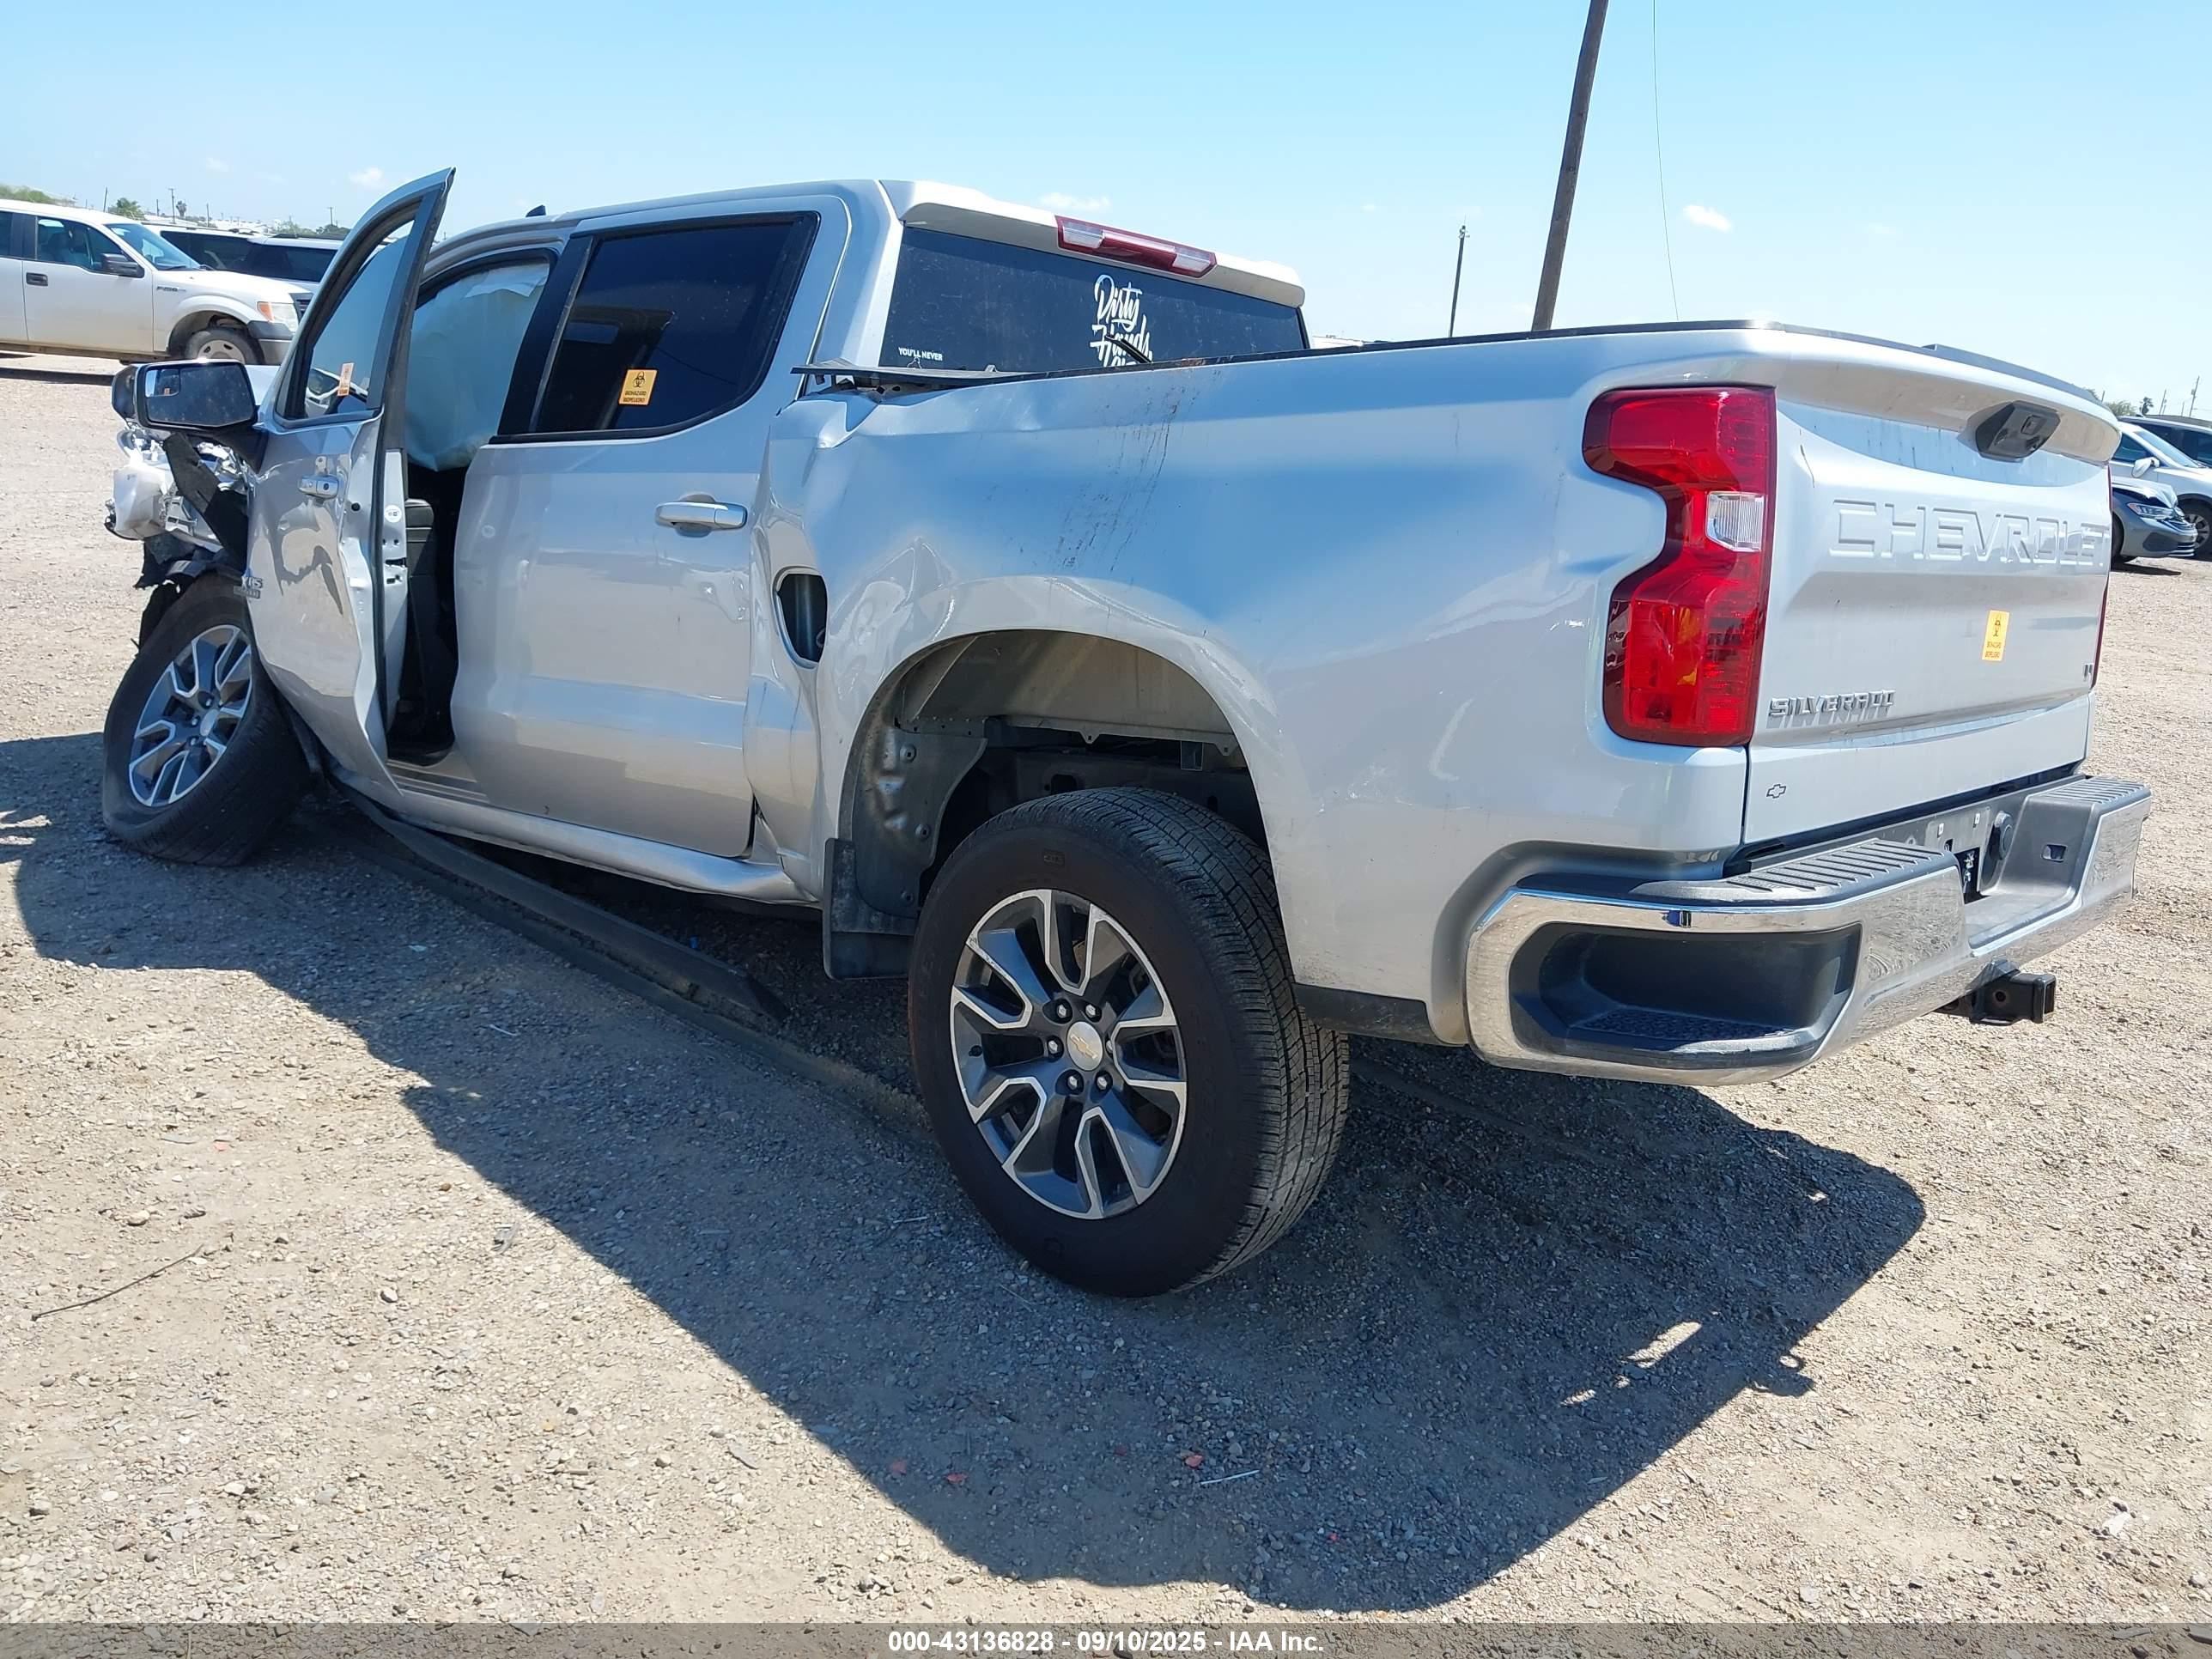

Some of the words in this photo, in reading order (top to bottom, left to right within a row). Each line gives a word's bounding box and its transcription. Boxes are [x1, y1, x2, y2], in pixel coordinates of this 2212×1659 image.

[1094, 274, 1143, 332] Dirty
[898, 347, 921, 358] YOU'LL
[921, 350, 943, 361] NEVER
